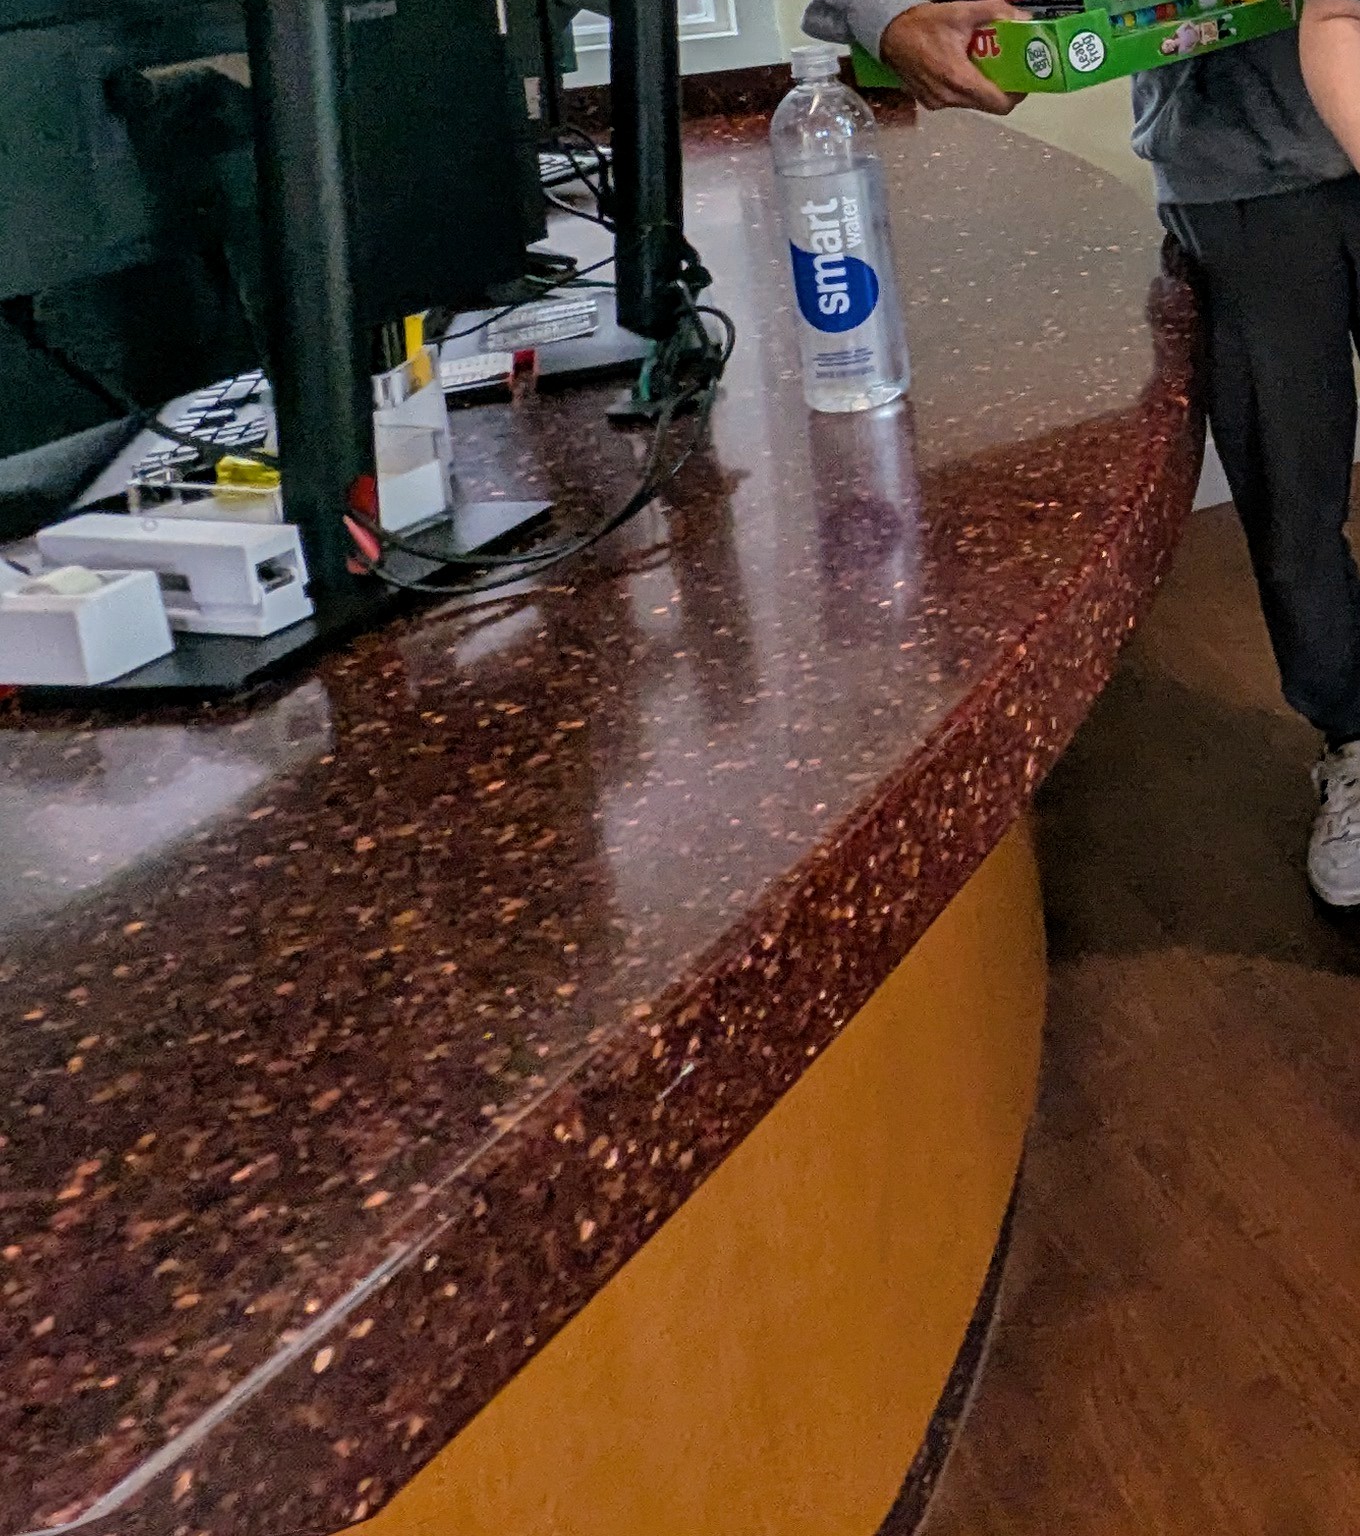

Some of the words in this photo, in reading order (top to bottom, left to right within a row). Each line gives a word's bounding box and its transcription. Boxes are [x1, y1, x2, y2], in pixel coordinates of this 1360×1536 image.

[1071, 40, 1092, 70] Leap
[1082, 34, 1102, 63] Frog
[841, 196, 864, 248] water
[800, 197, 850, 316] smart
